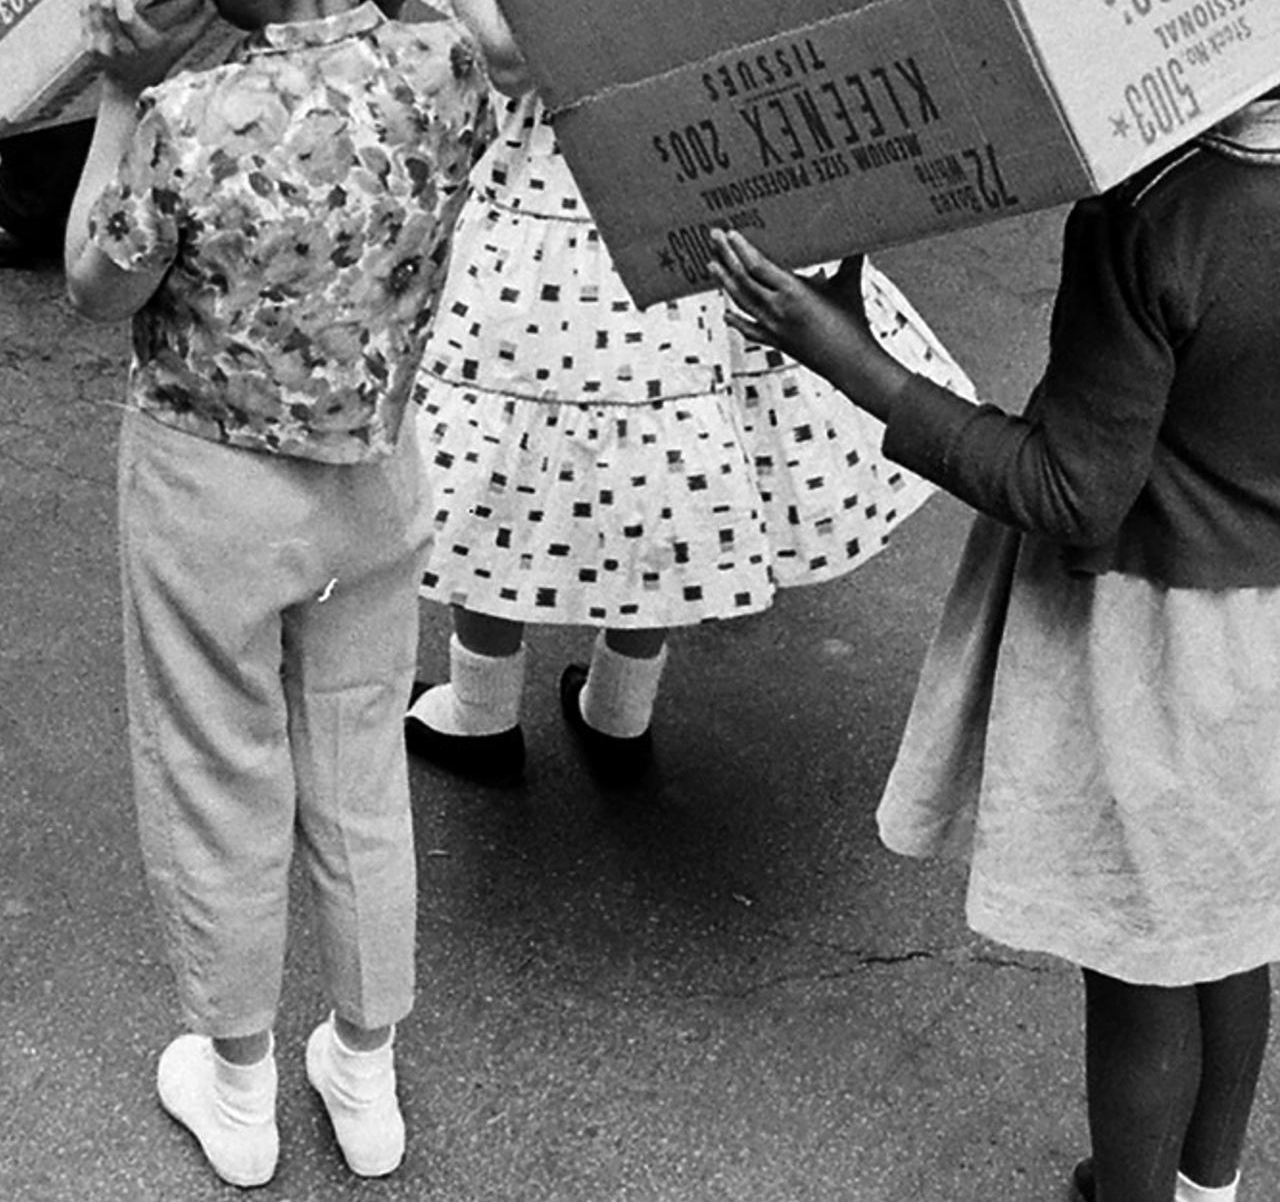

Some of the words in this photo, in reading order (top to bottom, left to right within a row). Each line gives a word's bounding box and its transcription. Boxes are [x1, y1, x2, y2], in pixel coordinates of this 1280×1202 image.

[1207, 16, 1252, 55] Stock
[702, 39, 827, 102] TISSUES
[739, 57, 941, 168] KLEENEX
[1124, 57, 1202, 146] 5103
[652, 119, 730, 184] 200's
[811, 153, 850, 183] SIZE
[851, 133, 923, 171] MEDIUM
[913, 155, 967, 189] White
[964, 143, 1019, 208] 72
[700, 163, 811, 211] PROFESSIONAL
[929, 185, 983, 215] Boxes
